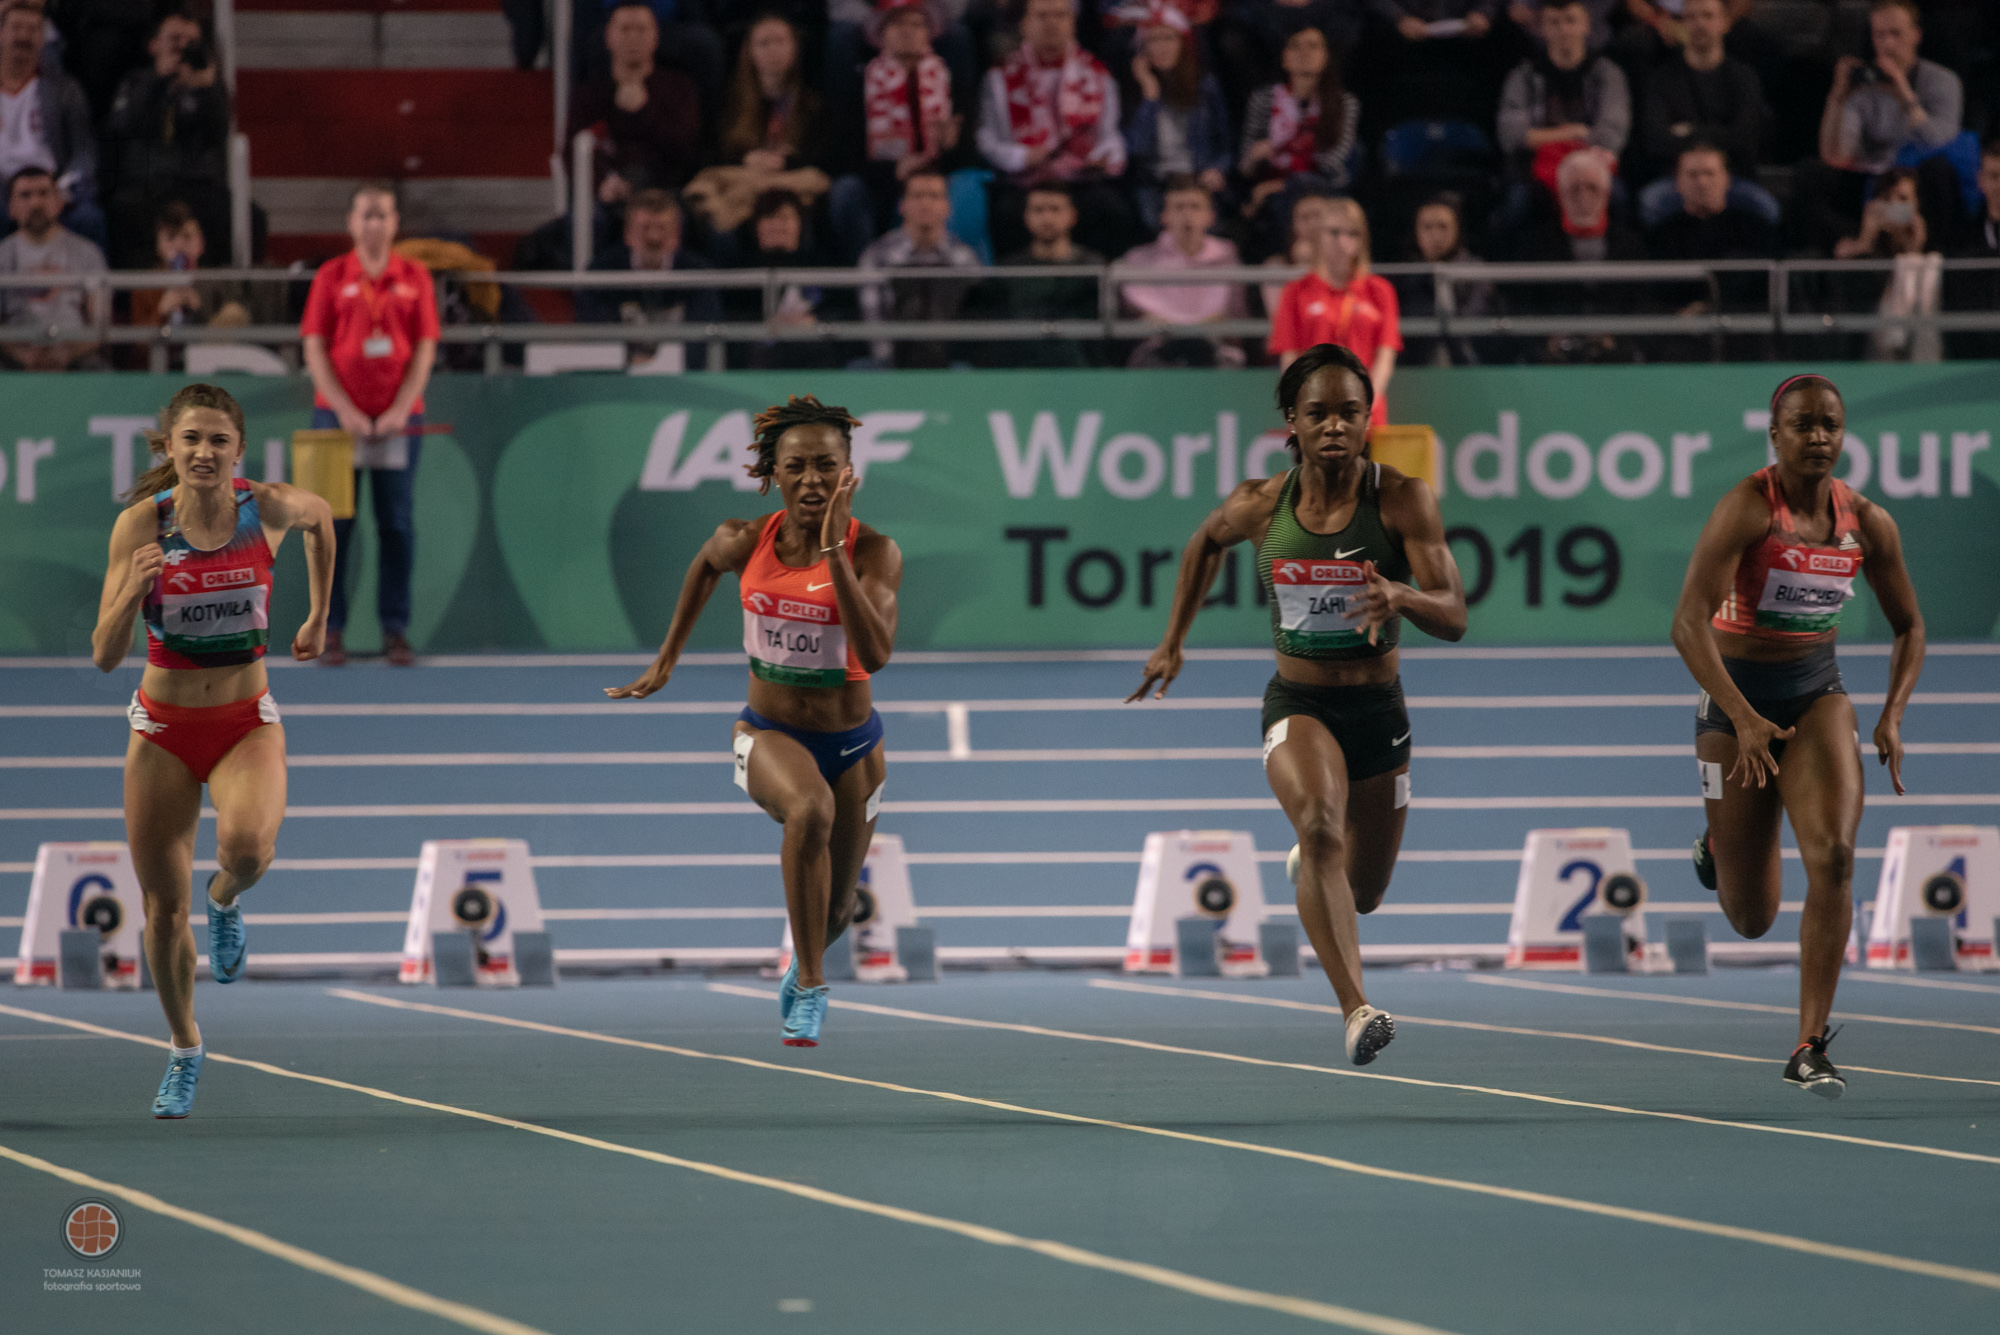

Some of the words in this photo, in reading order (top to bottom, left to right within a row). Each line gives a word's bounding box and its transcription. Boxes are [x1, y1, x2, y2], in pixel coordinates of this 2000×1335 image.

[639, 409, 926, 491] IAF
[206, 569, 251, 586] ORLEN
[1314, 567, 1361, 580] ORLEN
[1445, 523, 1624, 612] 019
[181, 600, 252, 622] KOTWIŁA
[781, 601, 827, 620] ORLEN
[1308, 596, 1347, 615] ZAHI
[764, 629, 783, 649] TA
[786, 633, 820, 654] LOU
[1555, 858, 1606, 932] 2
